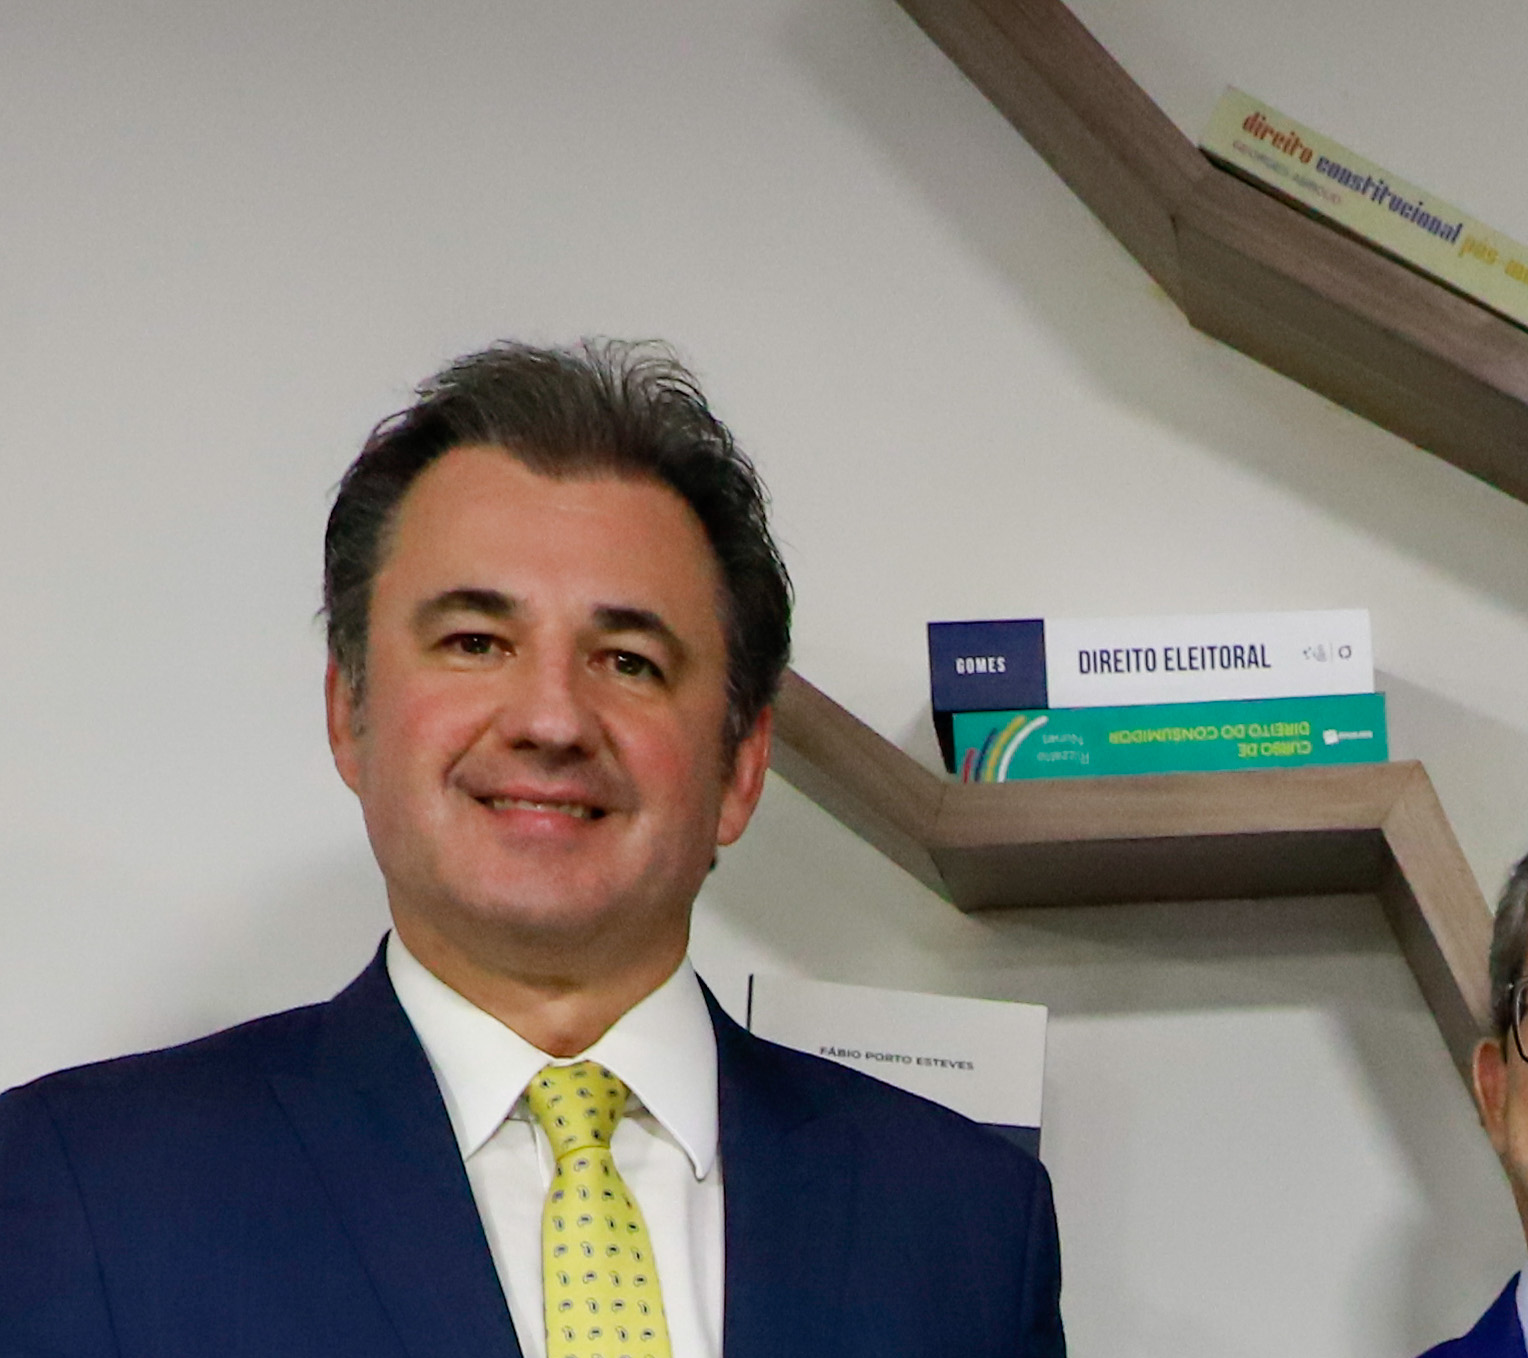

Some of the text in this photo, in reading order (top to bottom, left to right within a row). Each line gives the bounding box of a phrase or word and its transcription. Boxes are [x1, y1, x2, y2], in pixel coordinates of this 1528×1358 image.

[1241, 111, 1314, 164] direito
[1315, 154, 1463, 245] constitucional
[955, 655, 1007, 675] GOMES
[1078, 643, 1271, 674] DIREITO ELEITORAL
[1109, 722, 1310, 744] DIREITO DO CONSUMIDOR
[1238, 741, 1312, 757] CURSO DE
[819, 1045, 974, 1070] FÁBIO PORTO ESTEVES
